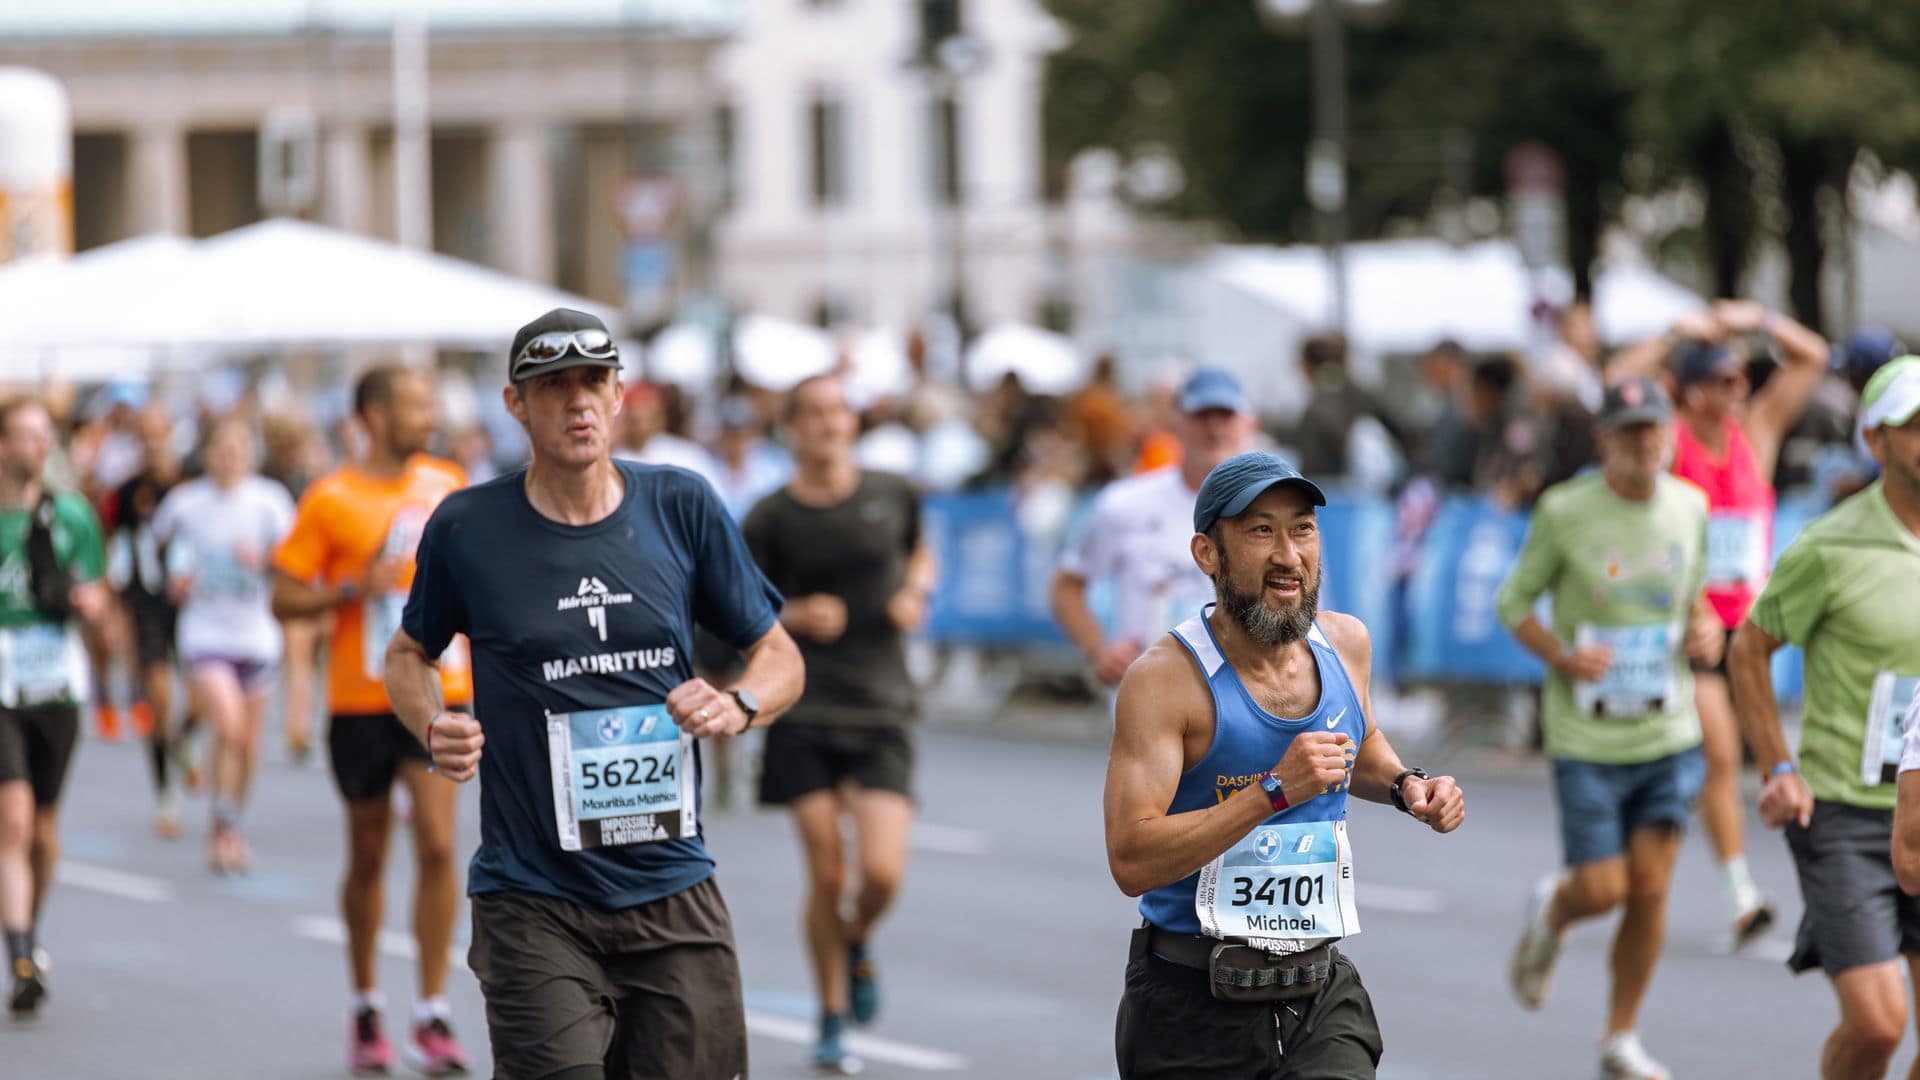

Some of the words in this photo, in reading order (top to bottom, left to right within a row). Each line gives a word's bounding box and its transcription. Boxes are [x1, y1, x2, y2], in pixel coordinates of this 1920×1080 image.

[601, 592, 633, 606] Team
[543, 647, 675, 681] MAURITIUS
[581, 754, 675, 790] 56224
[1216, 772, 1267, 787] DASHIN
[582, 795, 636, 810] Mauritius
[600, 814, 656, 832] IMPOSSIBLE
[601, 831, 613, 847] IS
[614, 825, 656, 846] NOTHING
[1342, 866, 1350, 879] E
[1207, 887, 1216, 905] 2022
[1231, 874, 1324, 907] 34101
[1246, 914, 1316, 931] Michael
[1247, 937, 1306, 953] IMPOSSIBLE
